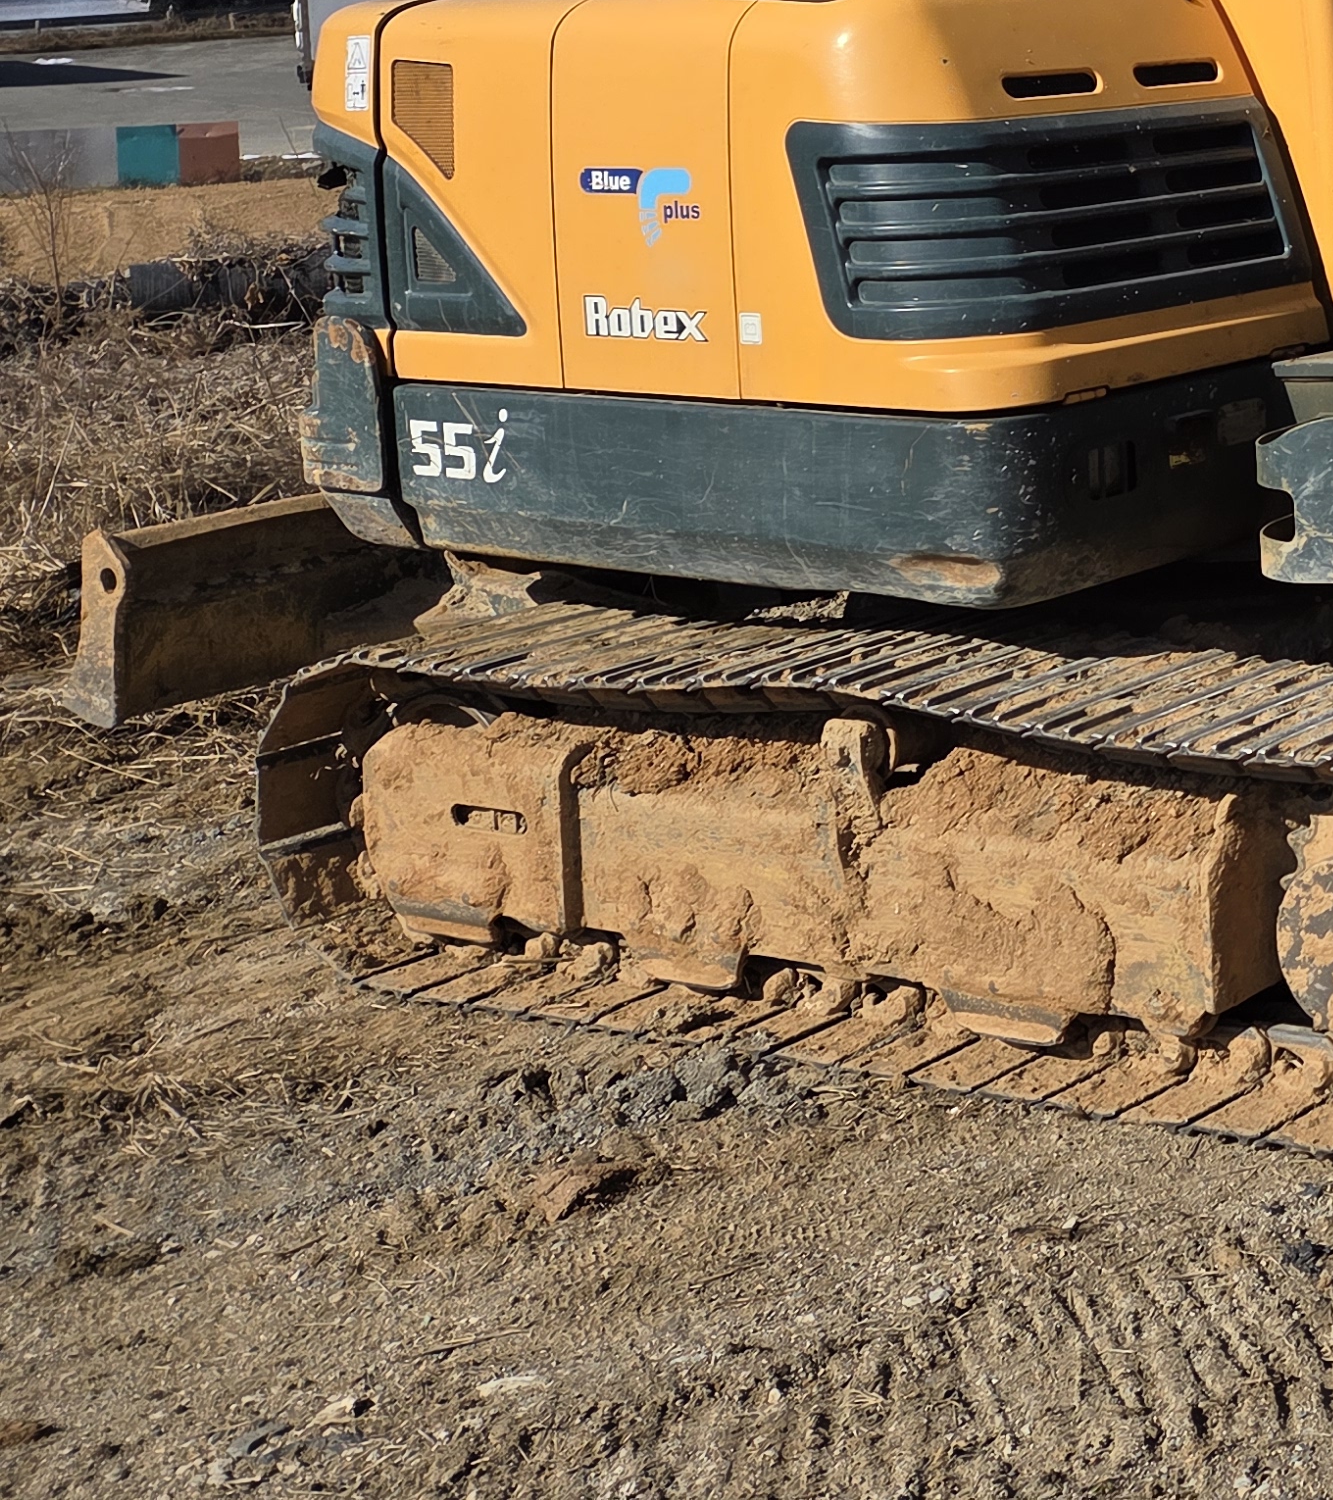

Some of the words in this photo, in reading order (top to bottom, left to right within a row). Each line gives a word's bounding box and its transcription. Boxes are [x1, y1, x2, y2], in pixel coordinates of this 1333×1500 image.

[590, 170, 632, 190] Blue
[663, 200, 700, 224] plus
[584, 295, 709, 342] Robex
